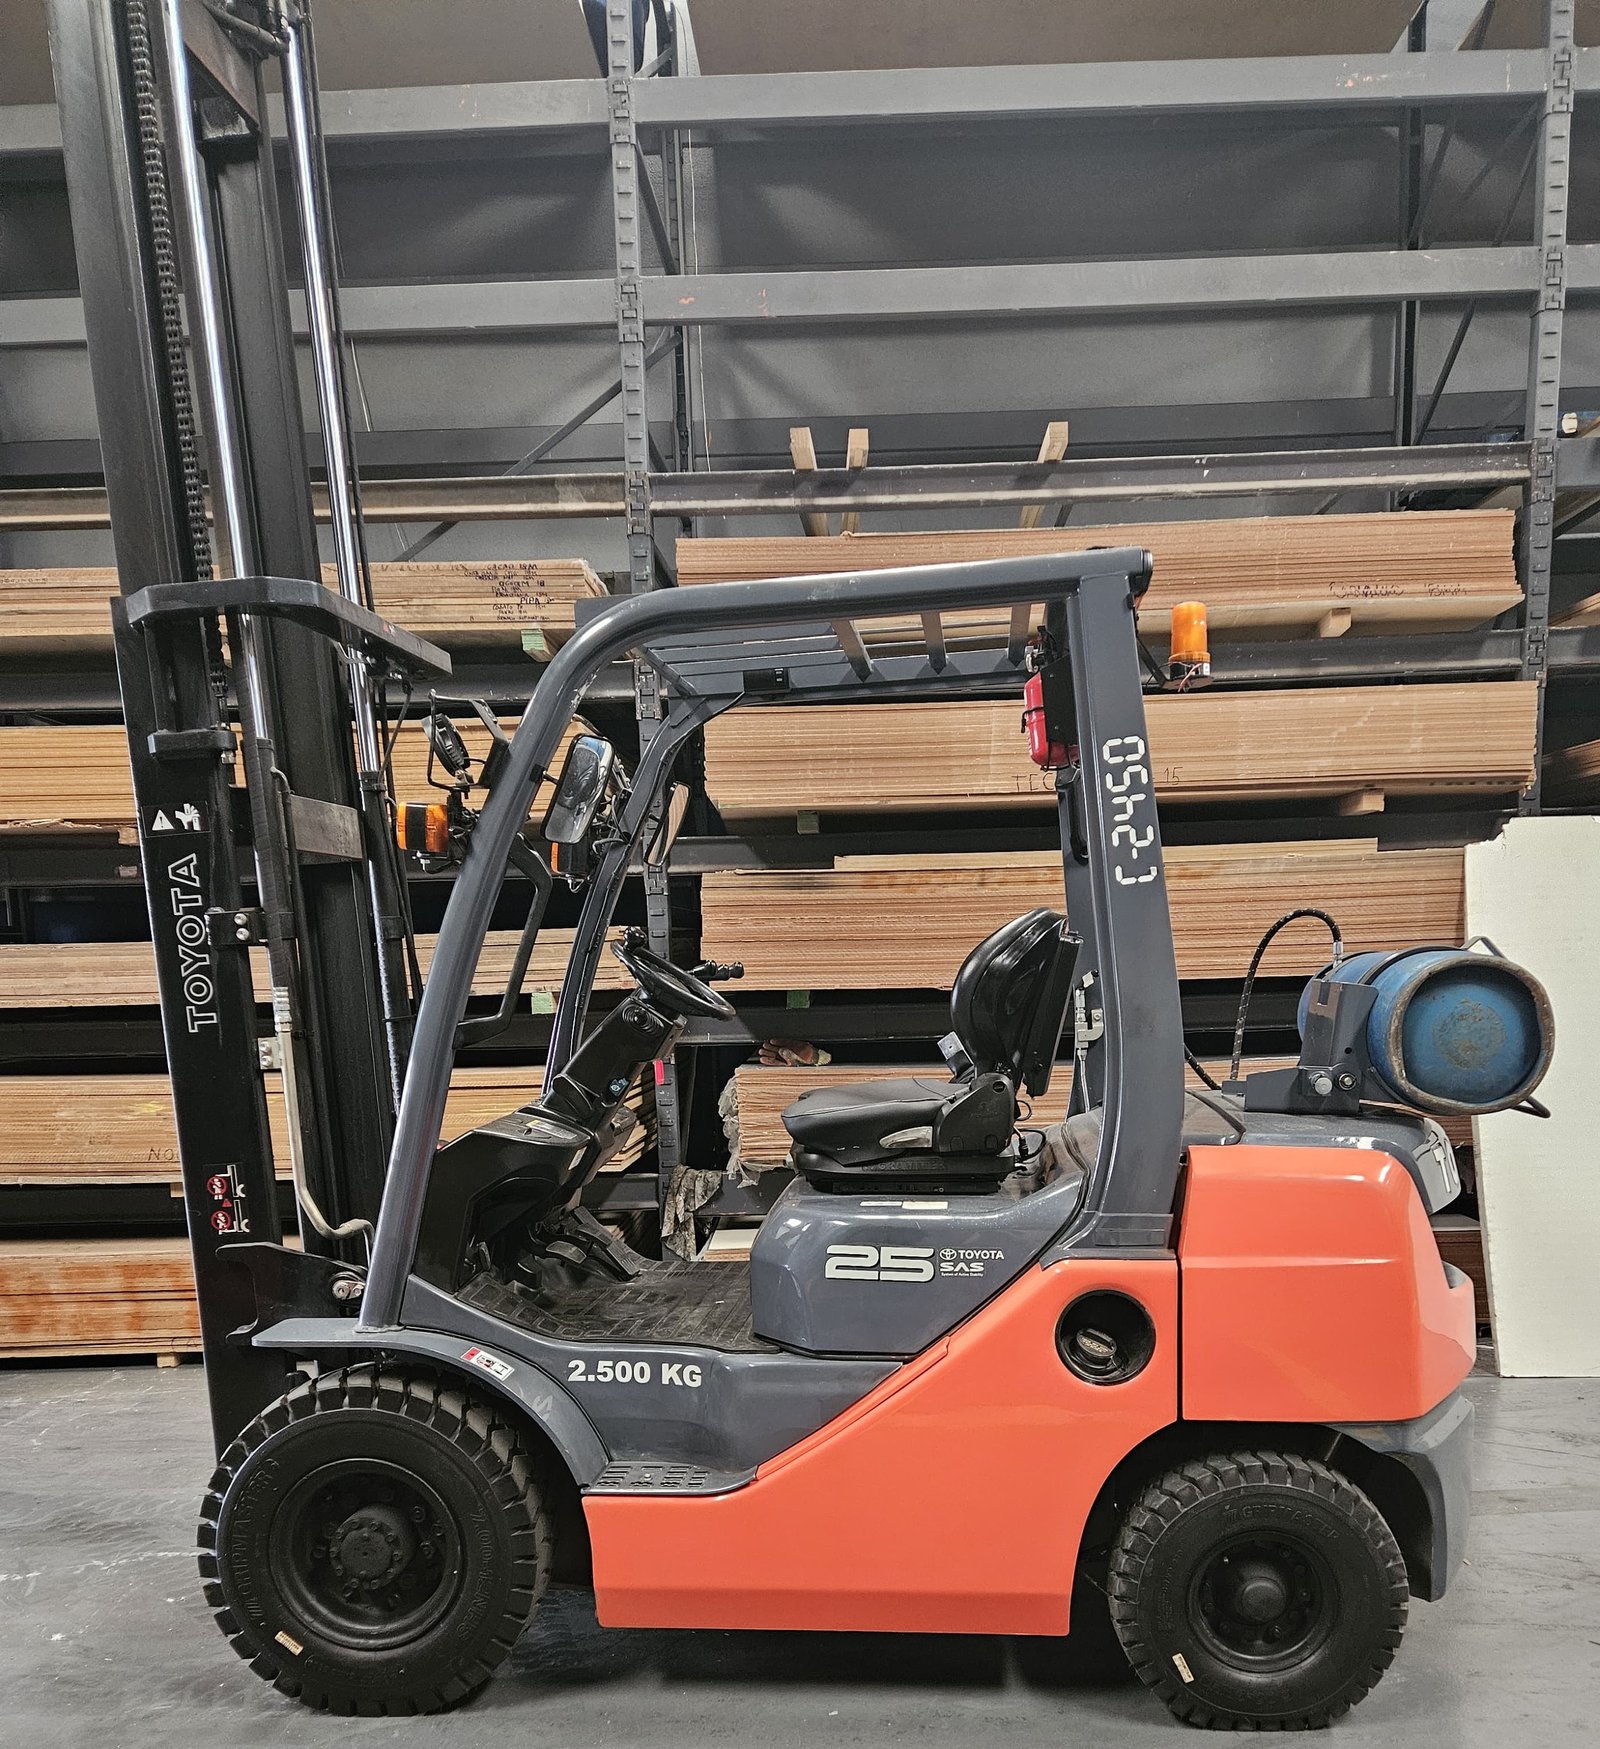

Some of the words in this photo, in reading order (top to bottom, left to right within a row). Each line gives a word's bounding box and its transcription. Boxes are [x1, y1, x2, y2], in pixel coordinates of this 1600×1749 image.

[167, 852, 218, 1033] TOYOTA
[148, 1148, 180, 1161] NO
[825, 1244, 935, 1283] 25
[957, 1250, 1005, 1260] TOYOTA
[939, 1262, 985, 1272] SAS
[567, 1359, 652, 1384] 2.500
[661, 1362, 703, 1388] KG
